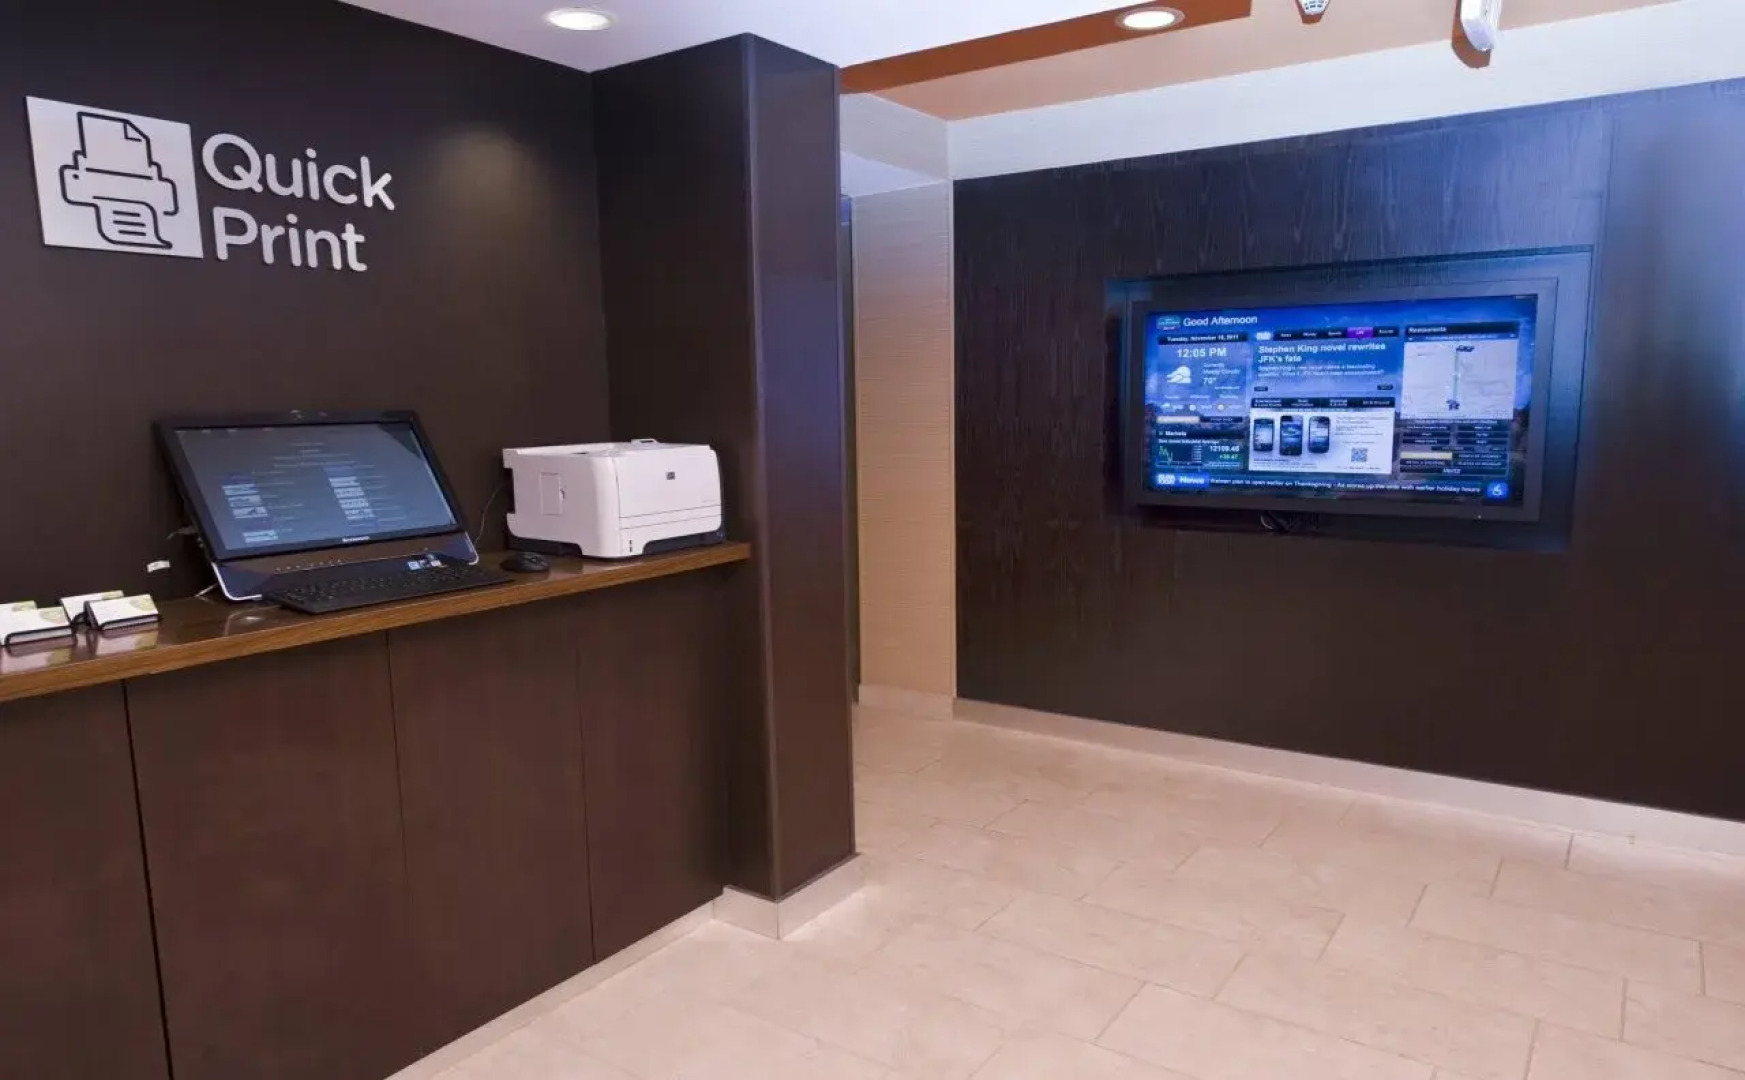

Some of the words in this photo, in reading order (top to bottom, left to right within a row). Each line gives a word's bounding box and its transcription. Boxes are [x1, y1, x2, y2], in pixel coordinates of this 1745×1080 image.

[201, 133, 395, 211] Quick
[213, 206, 367, 272] Print
[1182, 317, 1209, 327] Good
[1211, 315, 1258, 326] Afternoon
[1177, 348, 1206, 358] 12:05
[1208, 347, 1227, 357] PM
[1258, 345, 1295, 354] Stephen
[1297, 344, 1318, 354] King
[1320, 343, 1346, 352] novel
[1347, 342, 1386, 351] rewrites
[1258, 355, 1283, 363] JFK's
[1285, 354, 1302, 362] fate
[1179, 476, 1205, 485] News
[1436, 485, 1460, 493] holiday
